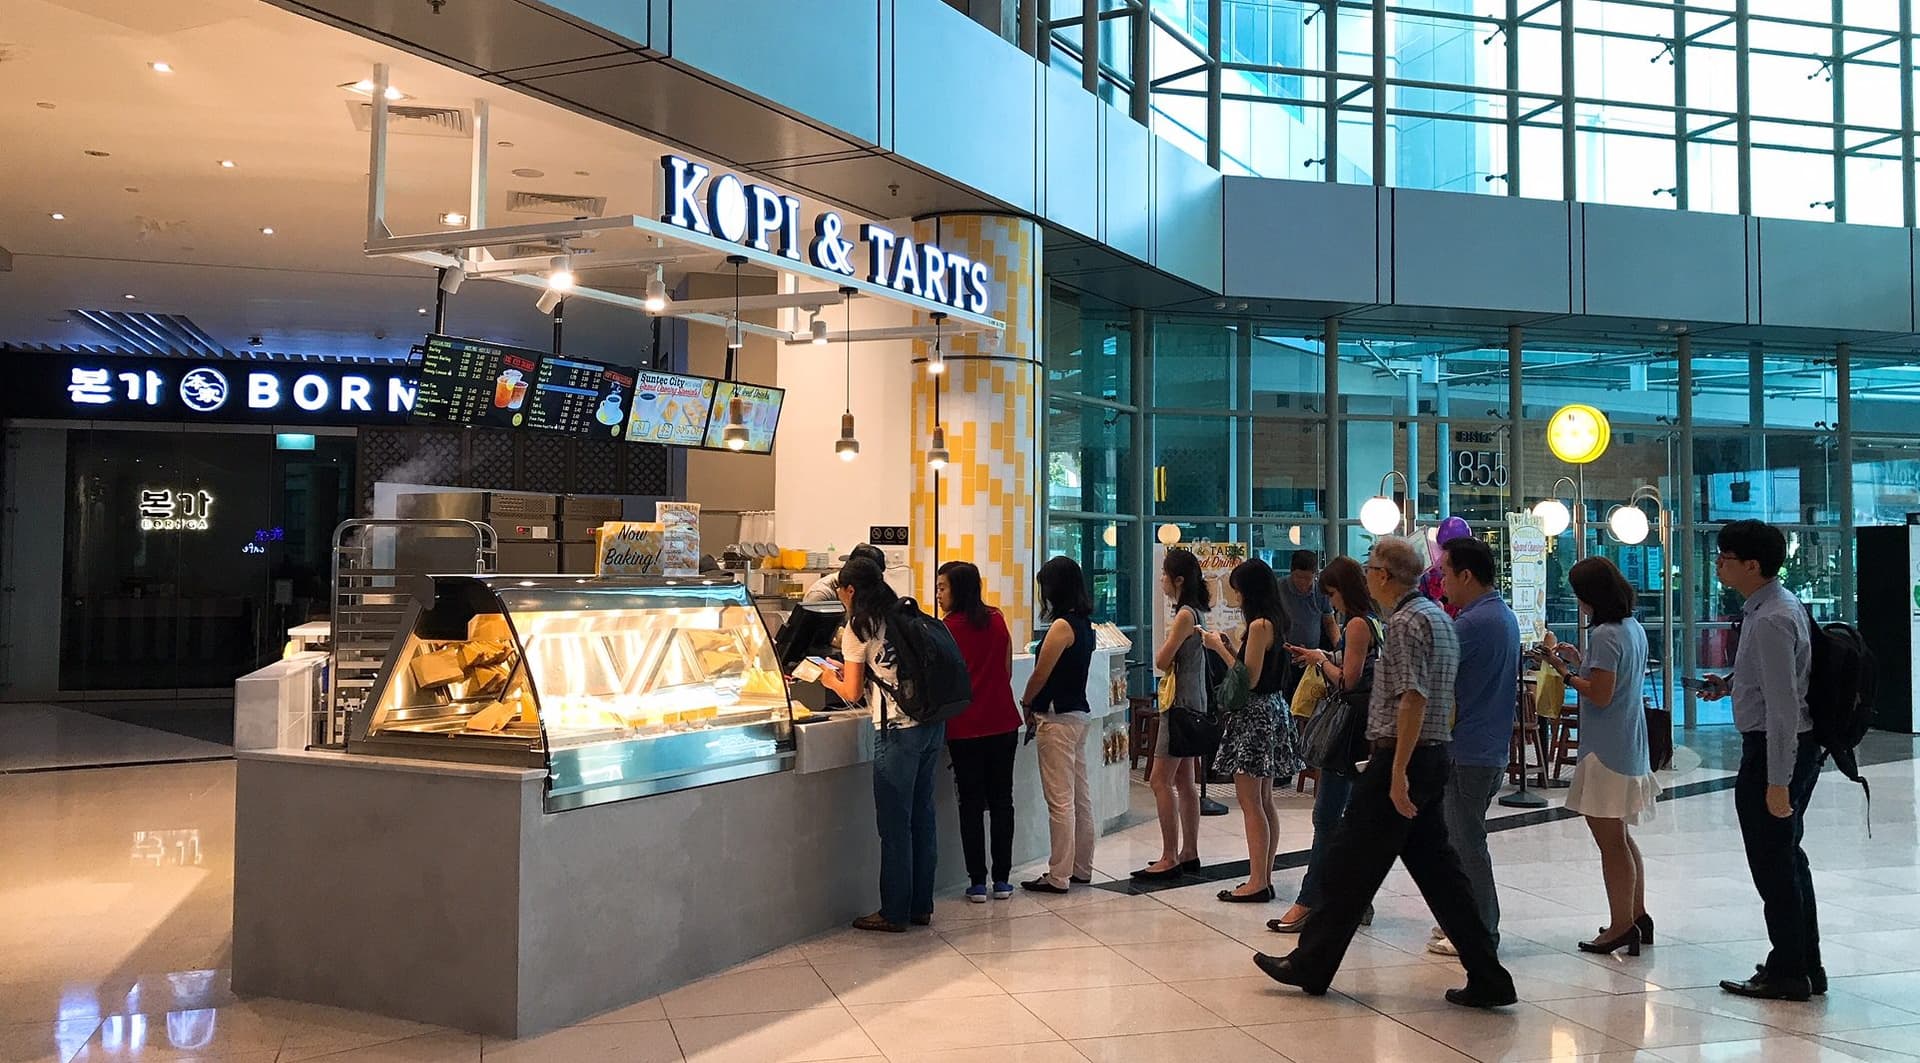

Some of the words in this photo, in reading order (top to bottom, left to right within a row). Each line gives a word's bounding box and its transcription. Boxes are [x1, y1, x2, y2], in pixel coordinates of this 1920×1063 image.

[662, 155, 801, 262] KOPI
[809, 211, 855, 276] &
[860, 224, 989, 314] TARTS
[67, 367, 163, 405] 본가
[640, 373, 668, 385] Suntec
[669, 376, 686, 388] City
[1449, 450, 1508, 487] 1855
[139, 489, 214, 518] 본가
[617, 524, 648, 542] Now
[604, 548, 662, 574] Baking!
